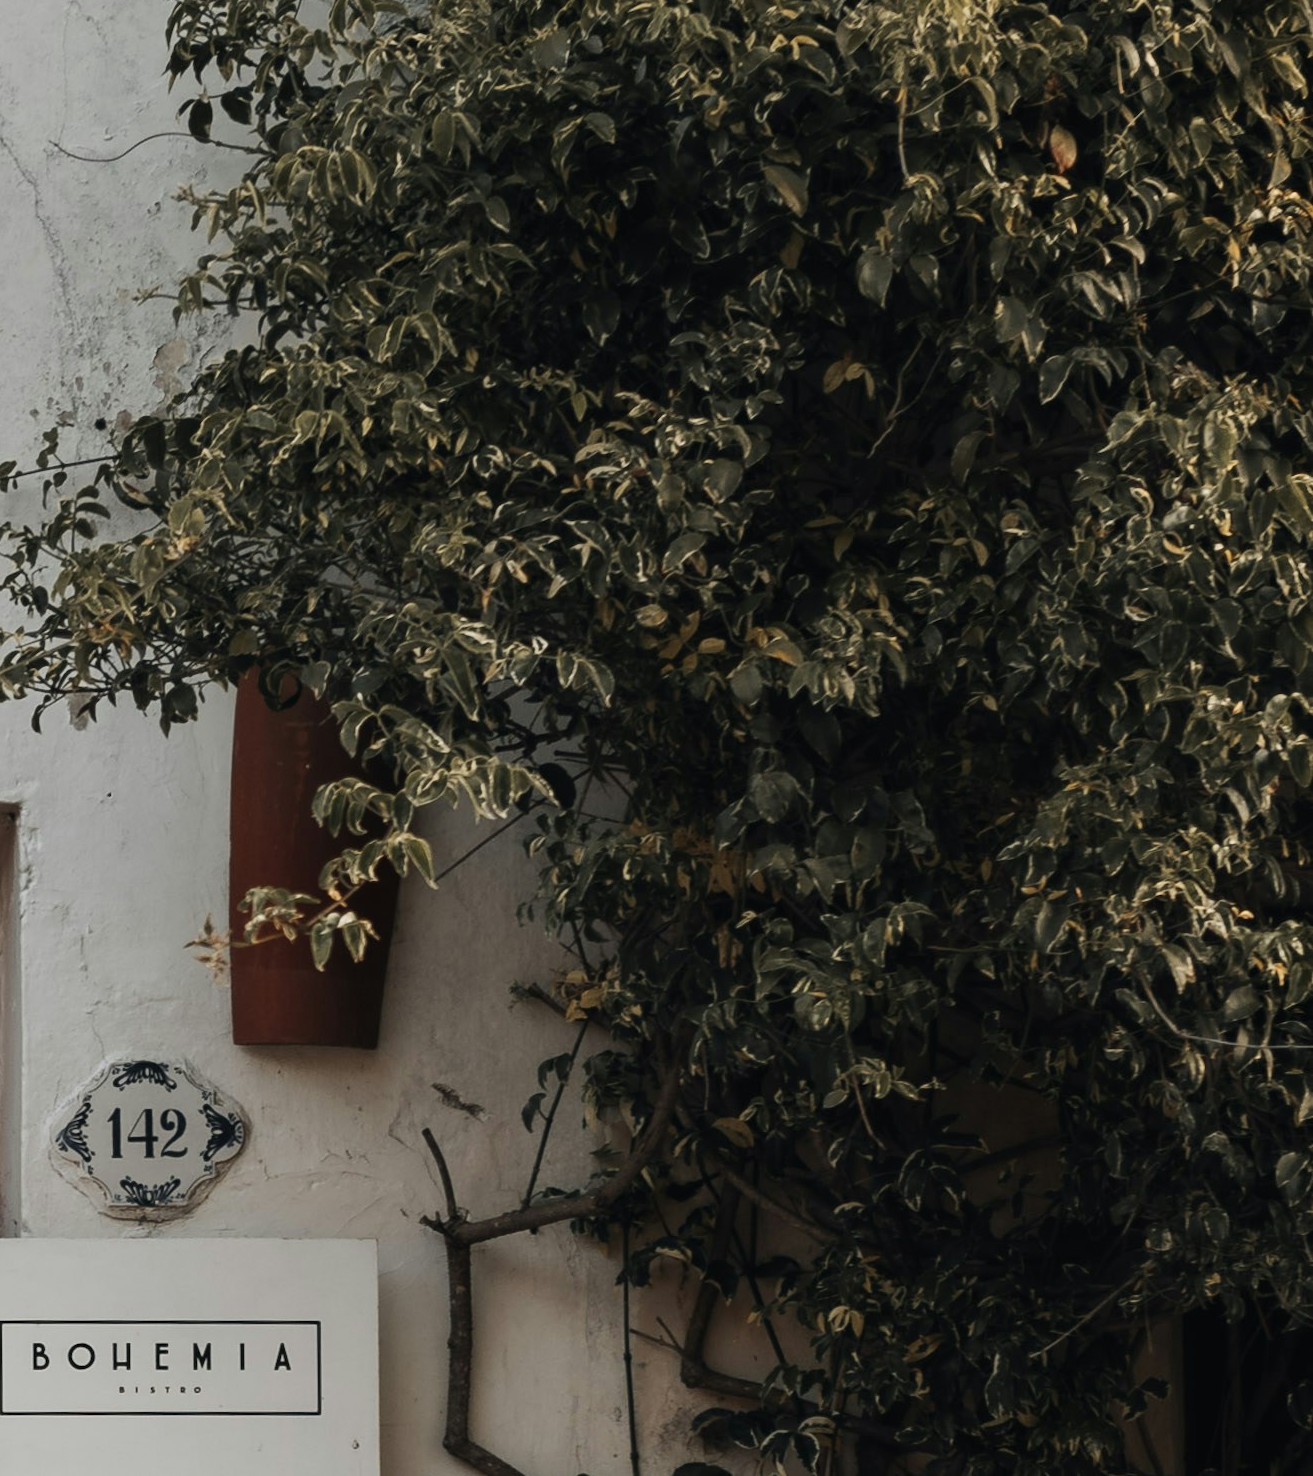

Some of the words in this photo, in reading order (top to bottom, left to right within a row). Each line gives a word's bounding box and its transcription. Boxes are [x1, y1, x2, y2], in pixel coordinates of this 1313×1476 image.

[106, 1106, 189, 1159] 142
[31, 1341, 293, 1371] BOHEMIA
[117, 1385, 202, 1394] BISTRO
